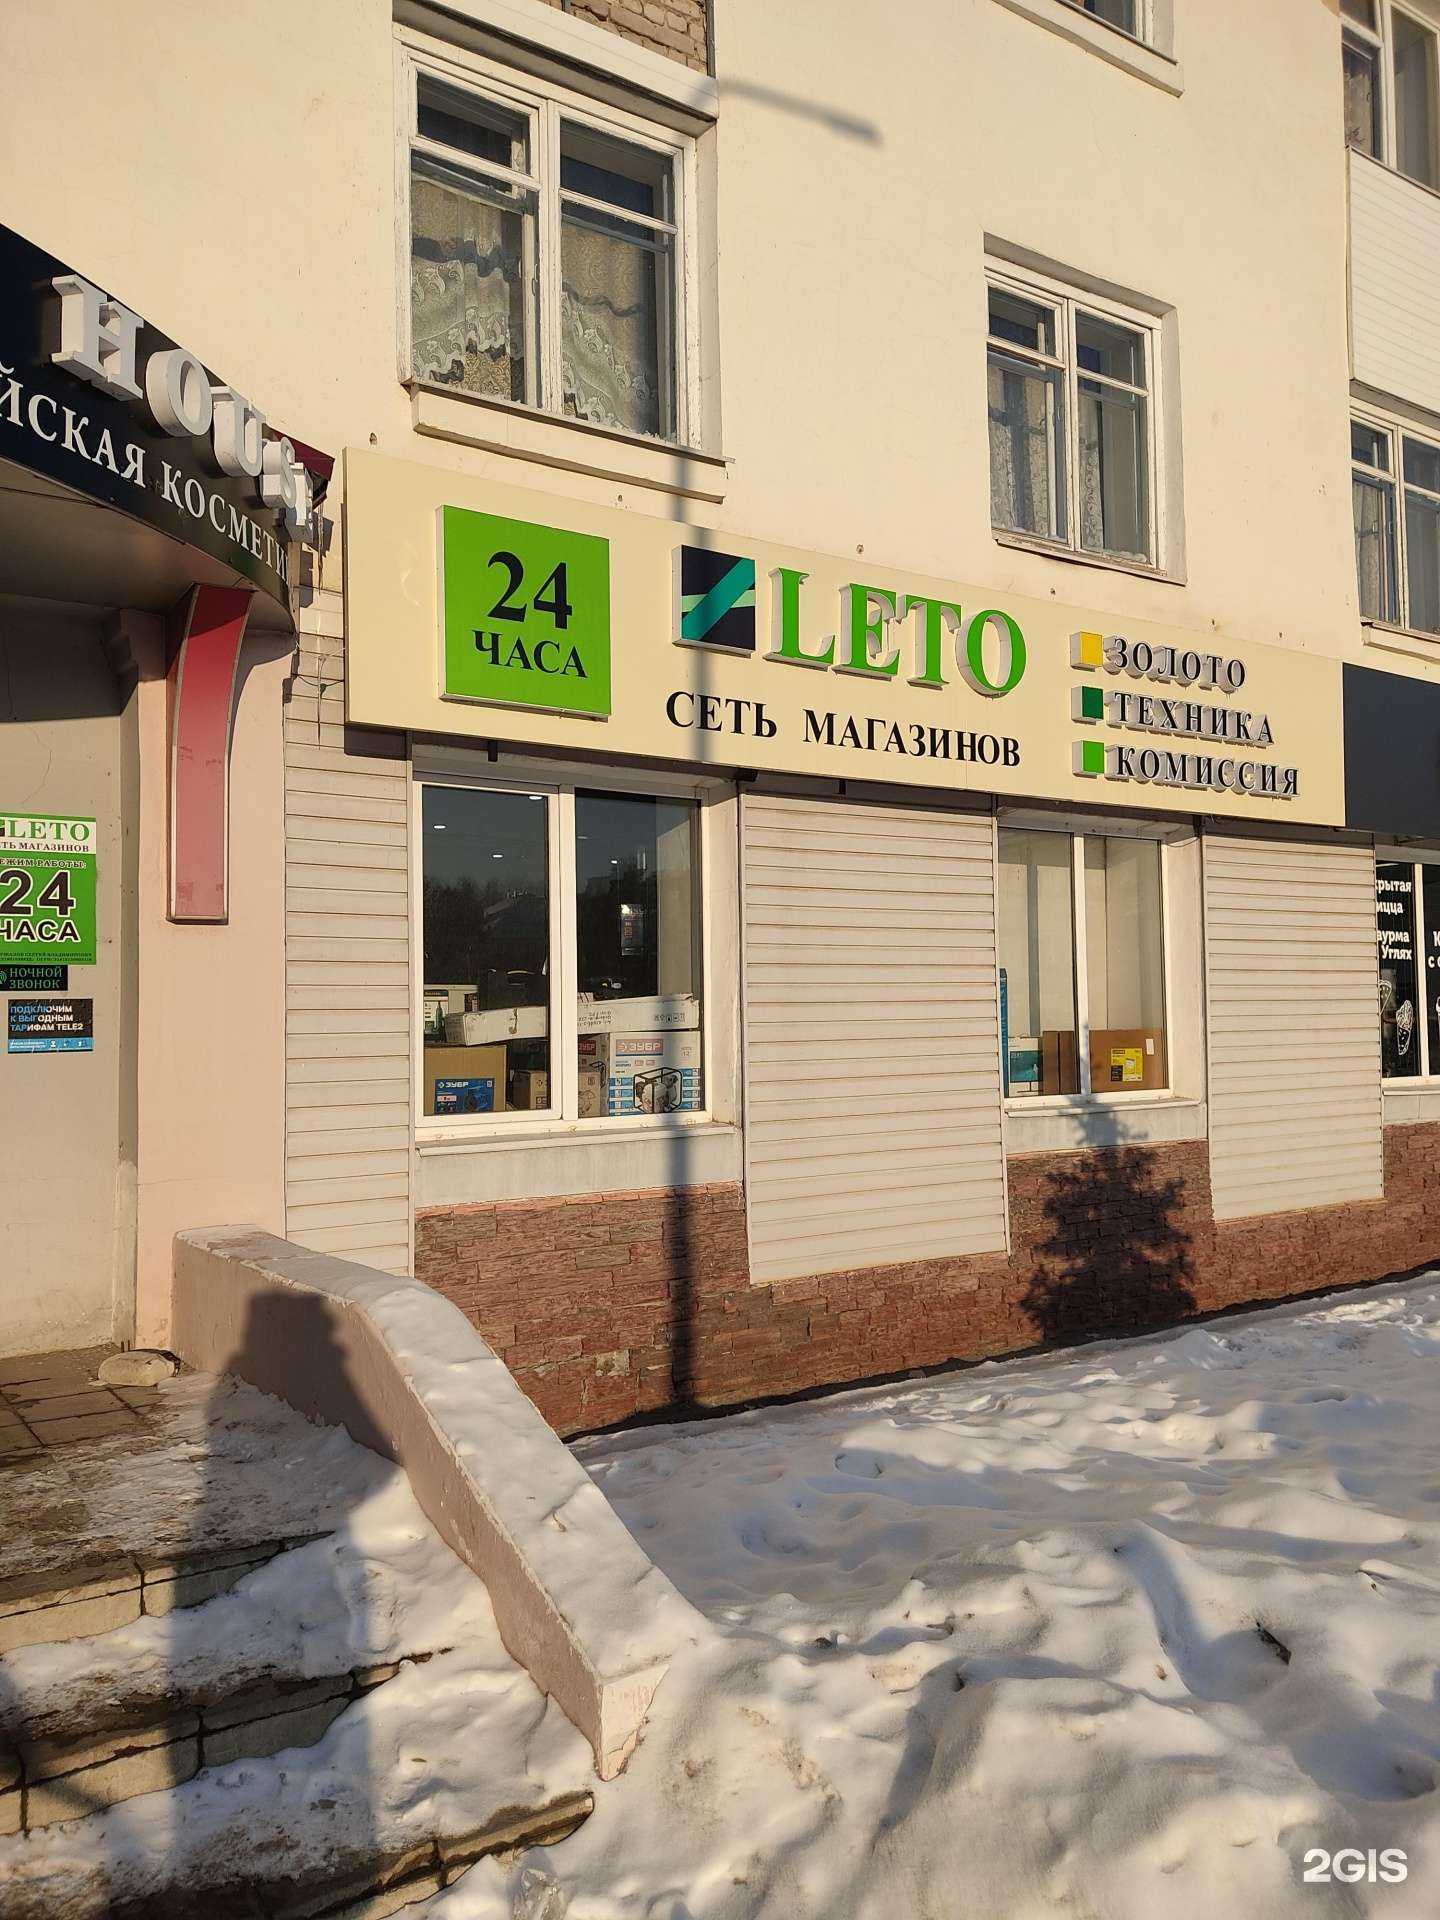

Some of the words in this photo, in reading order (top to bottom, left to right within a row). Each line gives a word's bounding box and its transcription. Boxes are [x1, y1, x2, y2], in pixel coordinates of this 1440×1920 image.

[161, 460, 289, 584] КОСМЕТИ
[487, 551, 573, 630] 24
[765, 567, 1027, 697] LETO
[472, 629, 588, 678] ЧАСА
[1107, 636, 1246, 690] ЗОЛОТО
[665, 691, 777, 738] СЕТЬ
[802, 708, 1021, 767] МАГАЗИНОВ
[1109, 691, 1275, 745] ТЕХНИКА
[1112, 746, 1300, 797] КОМИССИЯ
[8, 820, 90, 841] LETO
[19, 842, 89, 852] МАГАЗИНОВ
[0, 869, 76, 917] 24
[1381, 944, 1412, 960] Углях
[9, 967, 63, 978] НОЧНОЙ
[9, 979, 61, 989] ЗВОНОК
[10, 1004, 73, 1014] ПОДКЛЮЧИМ
[18, 1014, 74, 1023] ВЫГОДНЫМ
[10, 1023, 55, 1032] ТАРИФАМ
[56, 1023, 84, 1031] TELE2
[629, 1042, 661, 1052] ЗУБР
